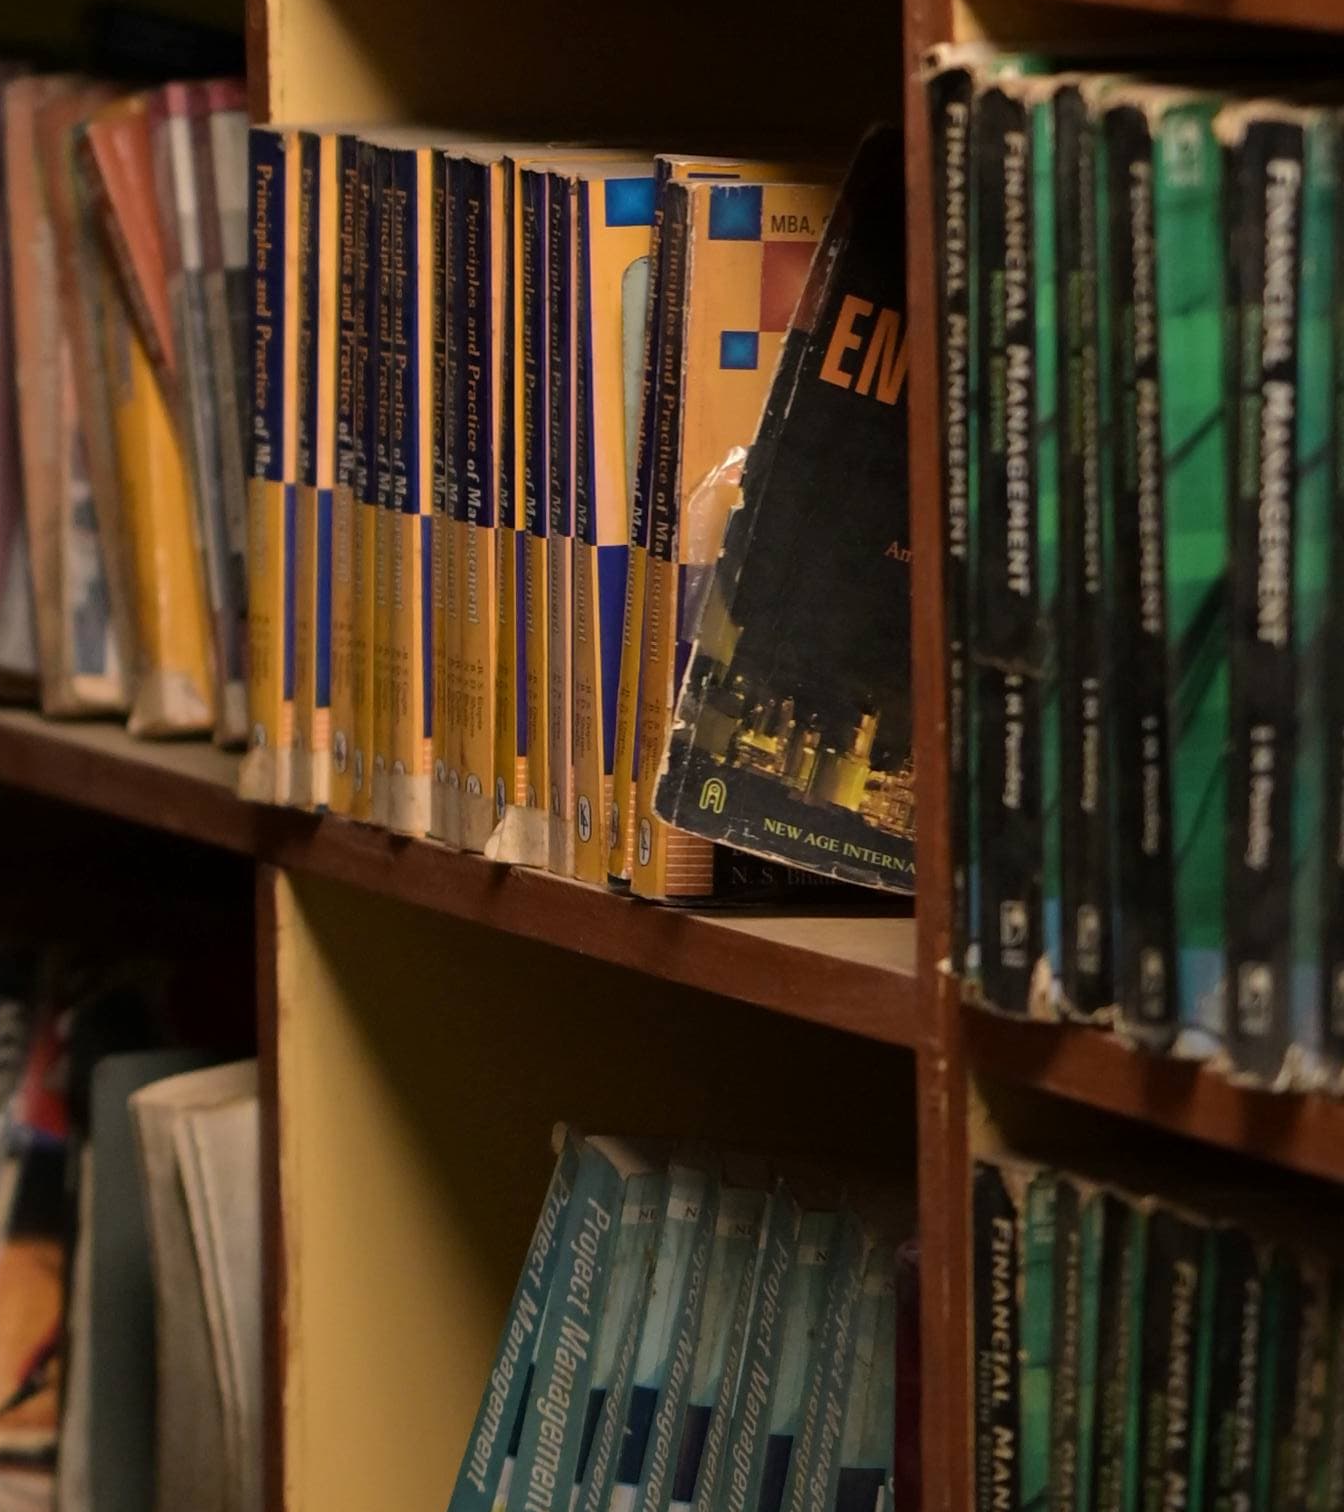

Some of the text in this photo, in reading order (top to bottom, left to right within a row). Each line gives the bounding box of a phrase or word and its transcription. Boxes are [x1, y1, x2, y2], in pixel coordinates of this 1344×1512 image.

[255, 164, 273, 272] Principles
[466, 197, 482, 310] Principles
[255, 278, 272, 317] and
[467, 315, 481, 358] and
[945, 101, 969, 560] FINANCIAL MANAGEMENT
[255, 325, 272, 411] Practice
[467, 363, 482, 452] Practice
[1005, 344, 1031, 598] MANAGEMENT
[763, 817, 804, 841] NEW
[803, 828, 840, 855] AGE
[566, 1196, 611, 1315] Project
[466, 1172, 571, 1493] Project Management
[990, 1217, 1013, 1408] FINANCIAL
